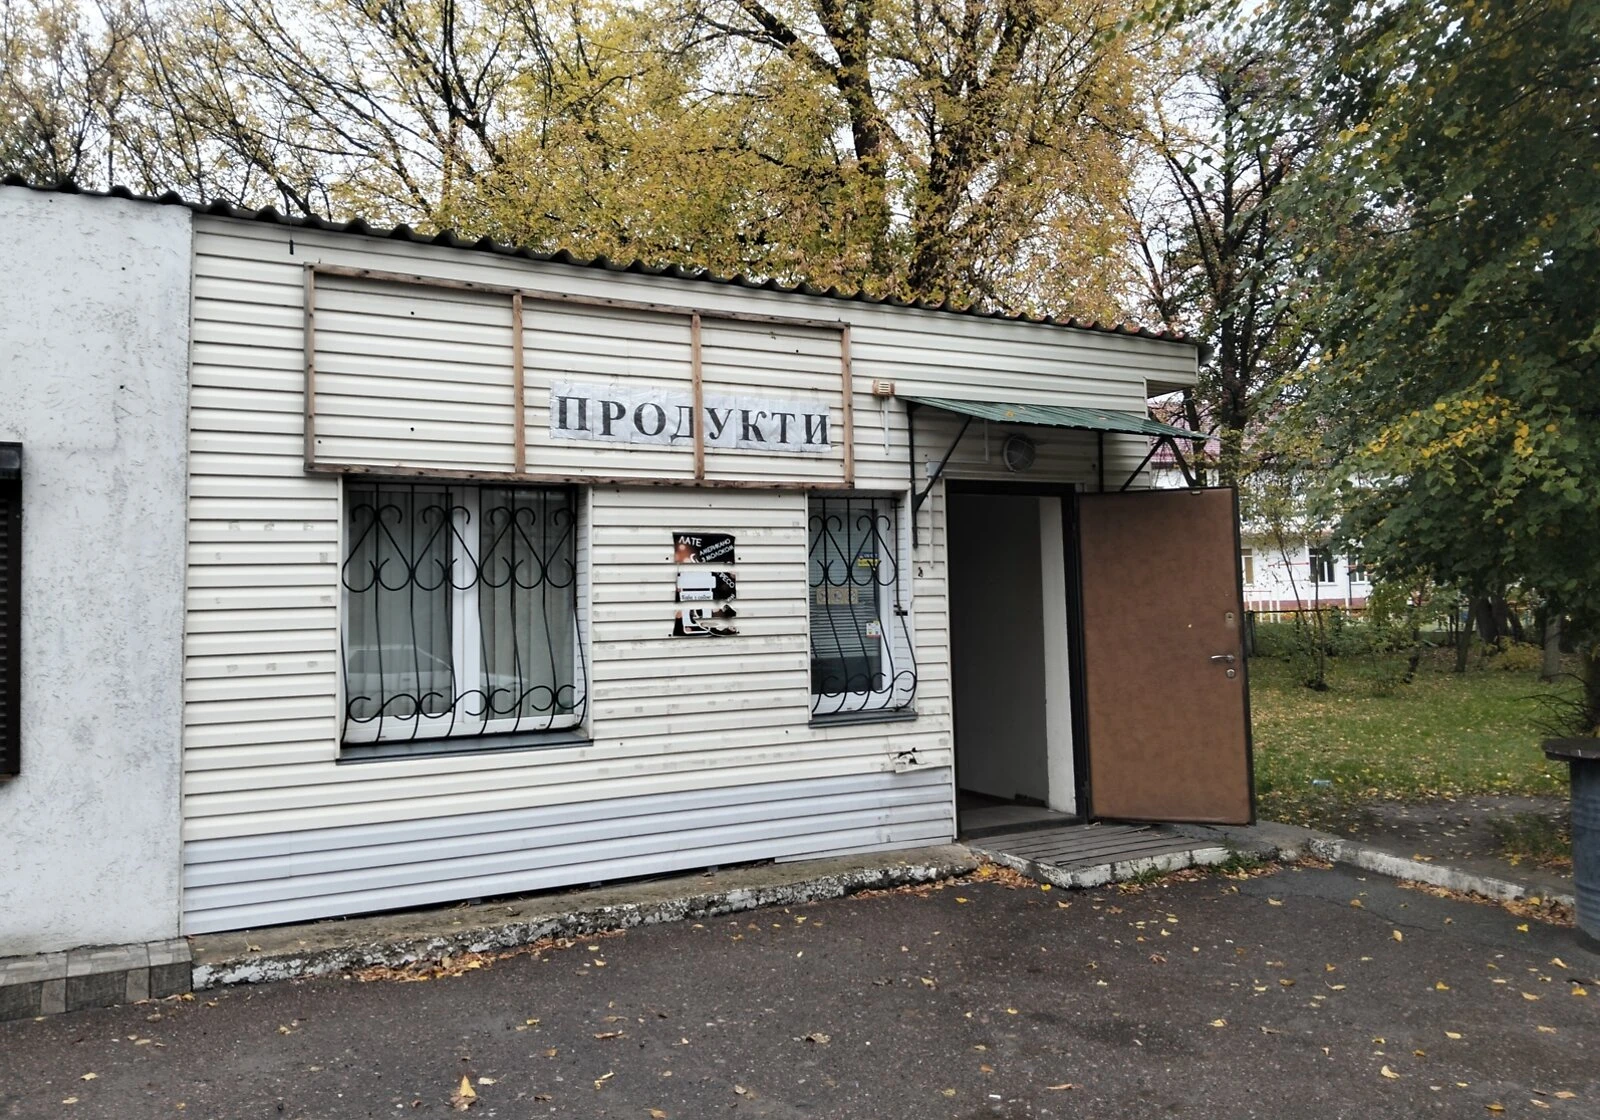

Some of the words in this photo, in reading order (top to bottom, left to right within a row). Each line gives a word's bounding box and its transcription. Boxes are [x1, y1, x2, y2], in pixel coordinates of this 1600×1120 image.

[555, 395, 830, 445] ПРОДУКТИ
[678, 535, 702, 547] ЛАТЕ
[719, 572, 735, 589] РЕСО
